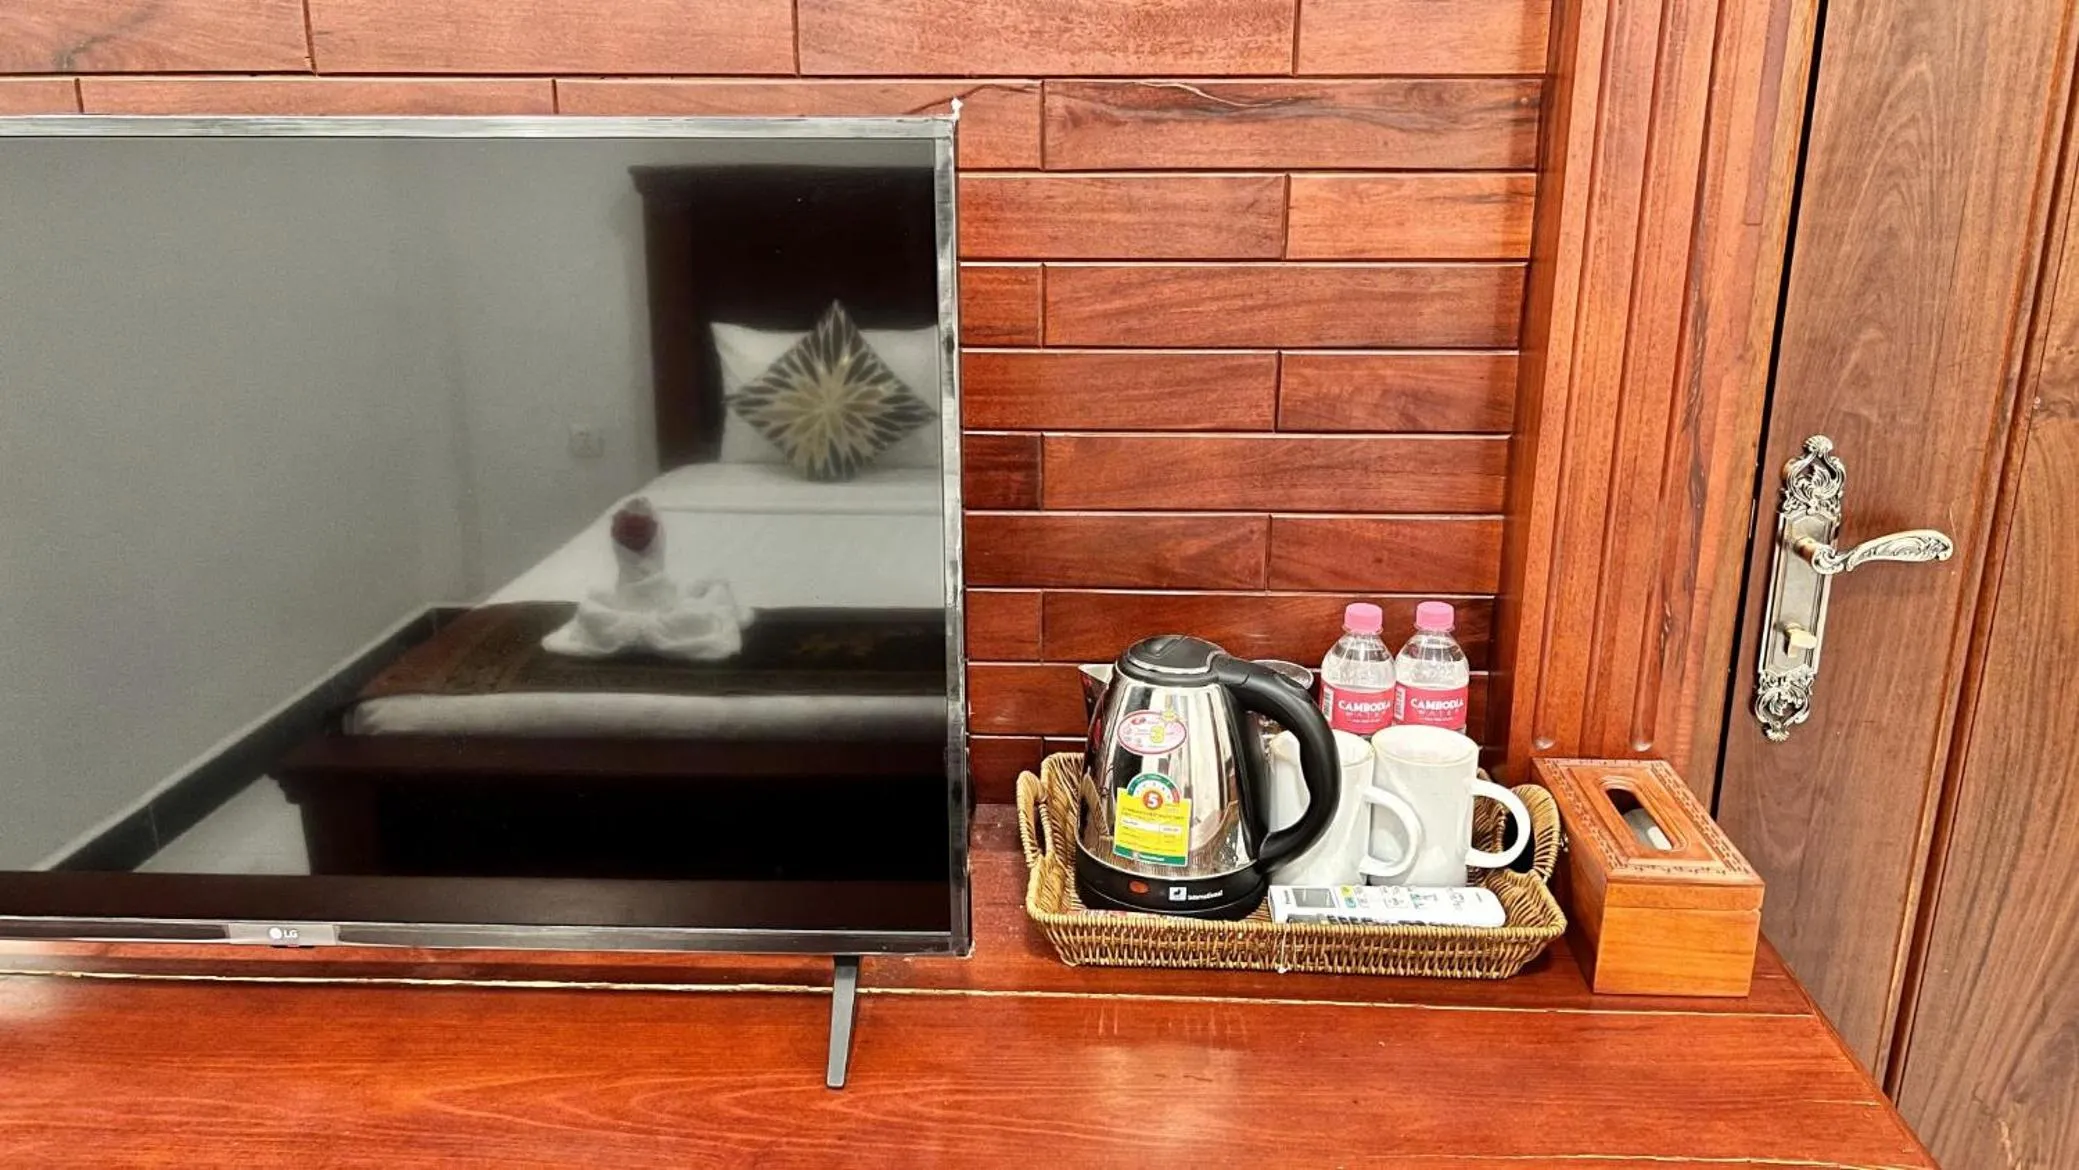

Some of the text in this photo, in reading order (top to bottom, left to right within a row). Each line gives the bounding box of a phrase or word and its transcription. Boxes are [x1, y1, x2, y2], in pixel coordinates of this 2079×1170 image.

[1410, 698, 1464, 710] CAMBODIA
[1148, 790, 1158, 808] 5
[284, 929, 298, 938] LG
